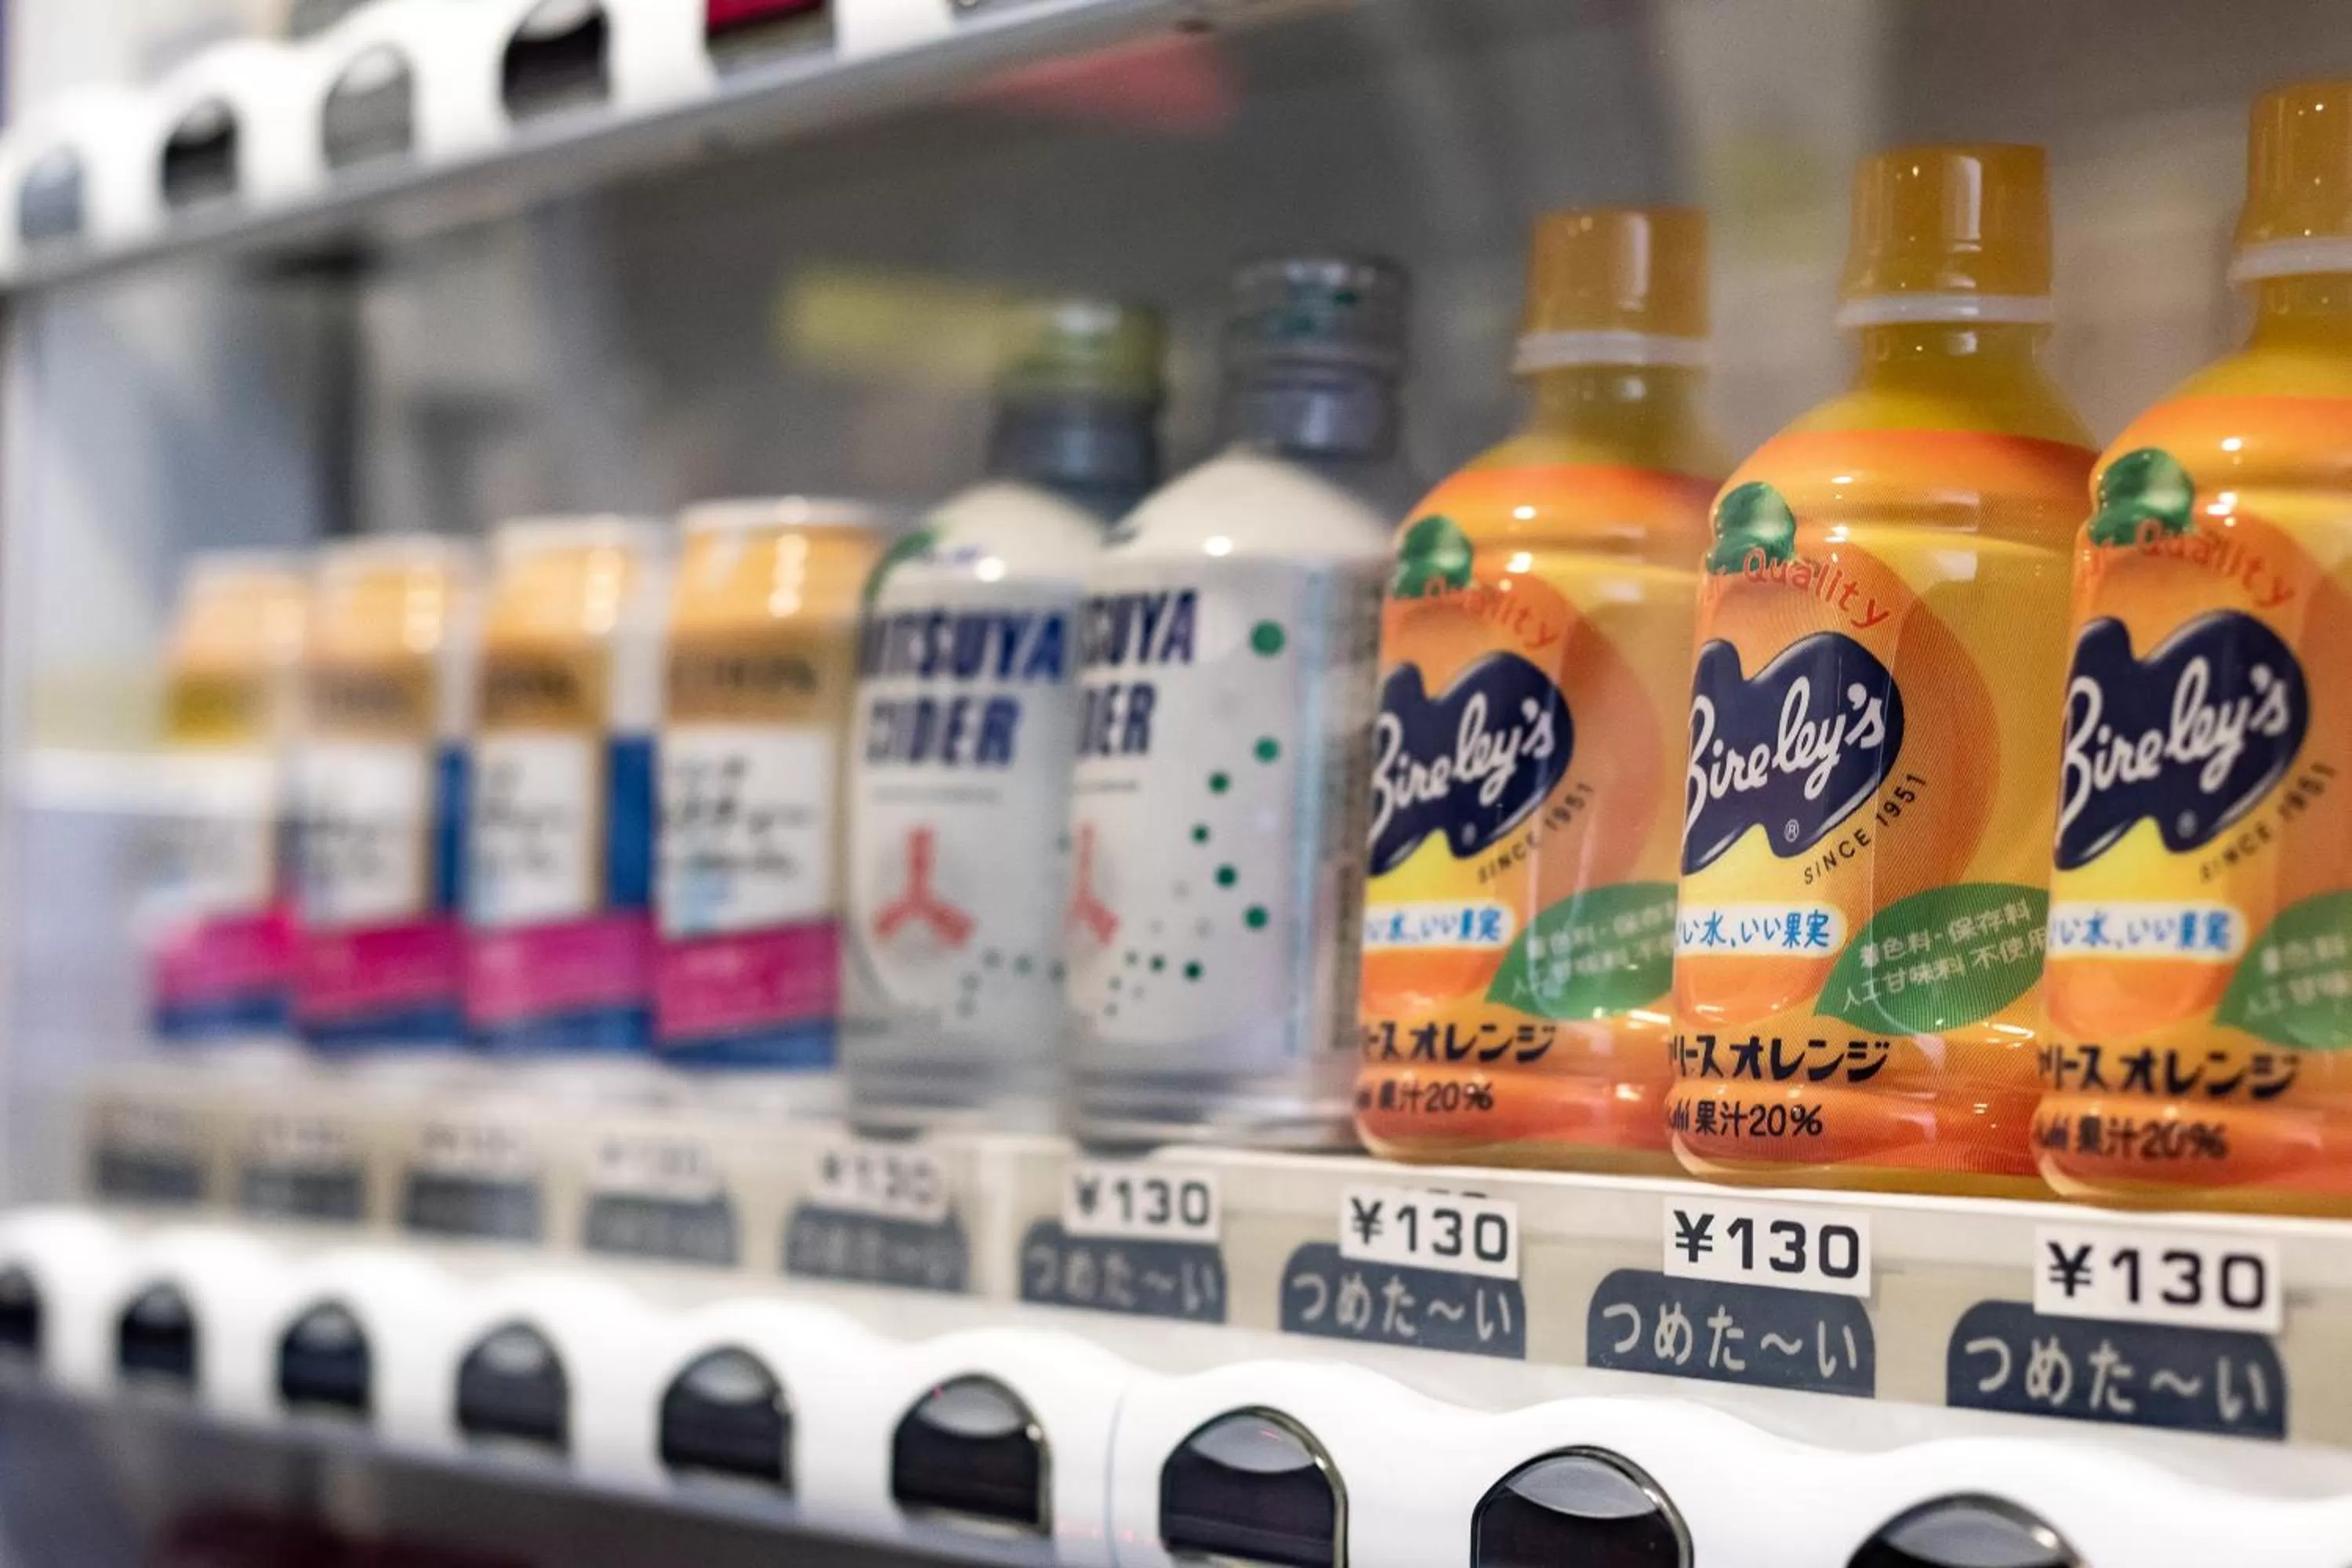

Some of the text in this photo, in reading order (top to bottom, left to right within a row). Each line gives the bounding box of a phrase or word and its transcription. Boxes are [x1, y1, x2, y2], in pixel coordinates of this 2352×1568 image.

[1743, 545, 1889, 629] Quality
[1366, 690, 1555, 851] Bireley's
[1682, 676, 1886, 848] Bireley's
[2057, 655, 2290, 837] Bireley's
[1804, 774, 1926, 885] SINCE 1951
[1073, 1175, 1210, 1227] ¥130
[1350, 1196, 1509, 1264] ¥130
[1674, 1210, 1860, 1279] ¥130
[2046, 1240, 2267, 1311] ¥130
